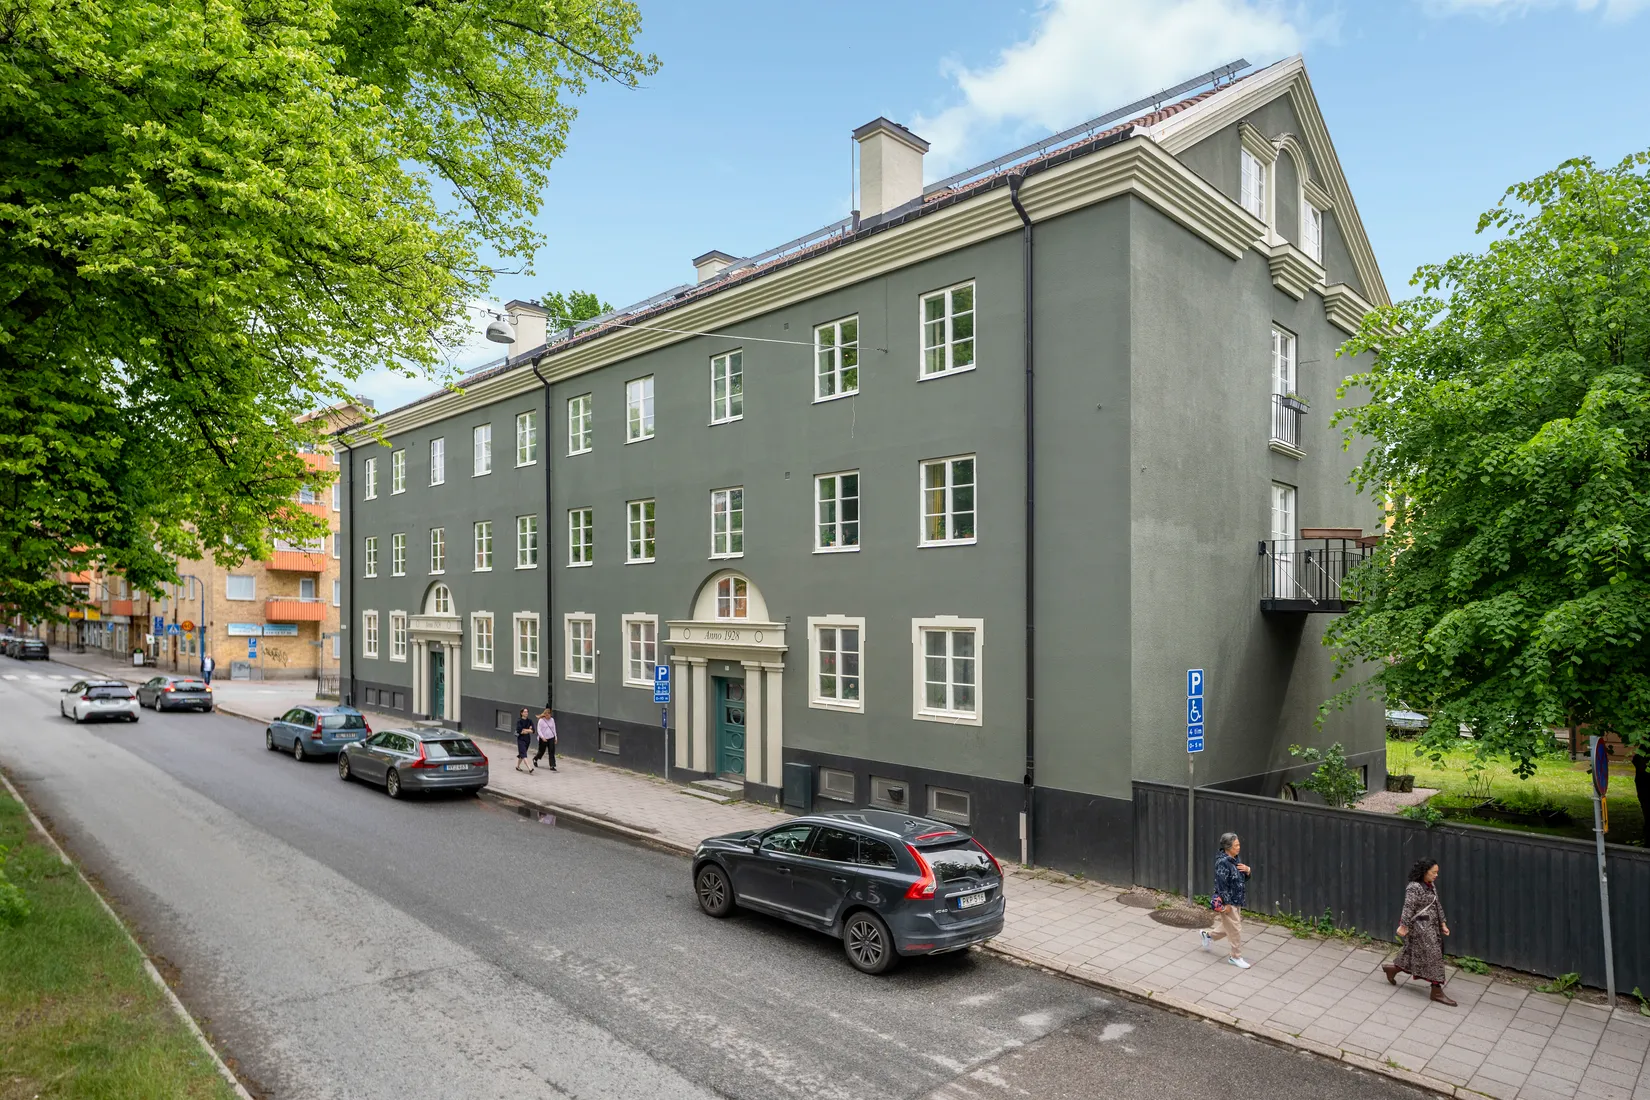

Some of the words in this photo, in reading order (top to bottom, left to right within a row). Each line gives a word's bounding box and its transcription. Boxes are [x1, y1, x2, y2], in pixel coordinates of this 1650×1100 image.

[704, 630, 722, 641] Anno
[724, 630, 740, 641] 1928
[658, 667, 667, 680] P
[1192, 672, 1201, 694] P
[962, 896, 973, 904] PKP
